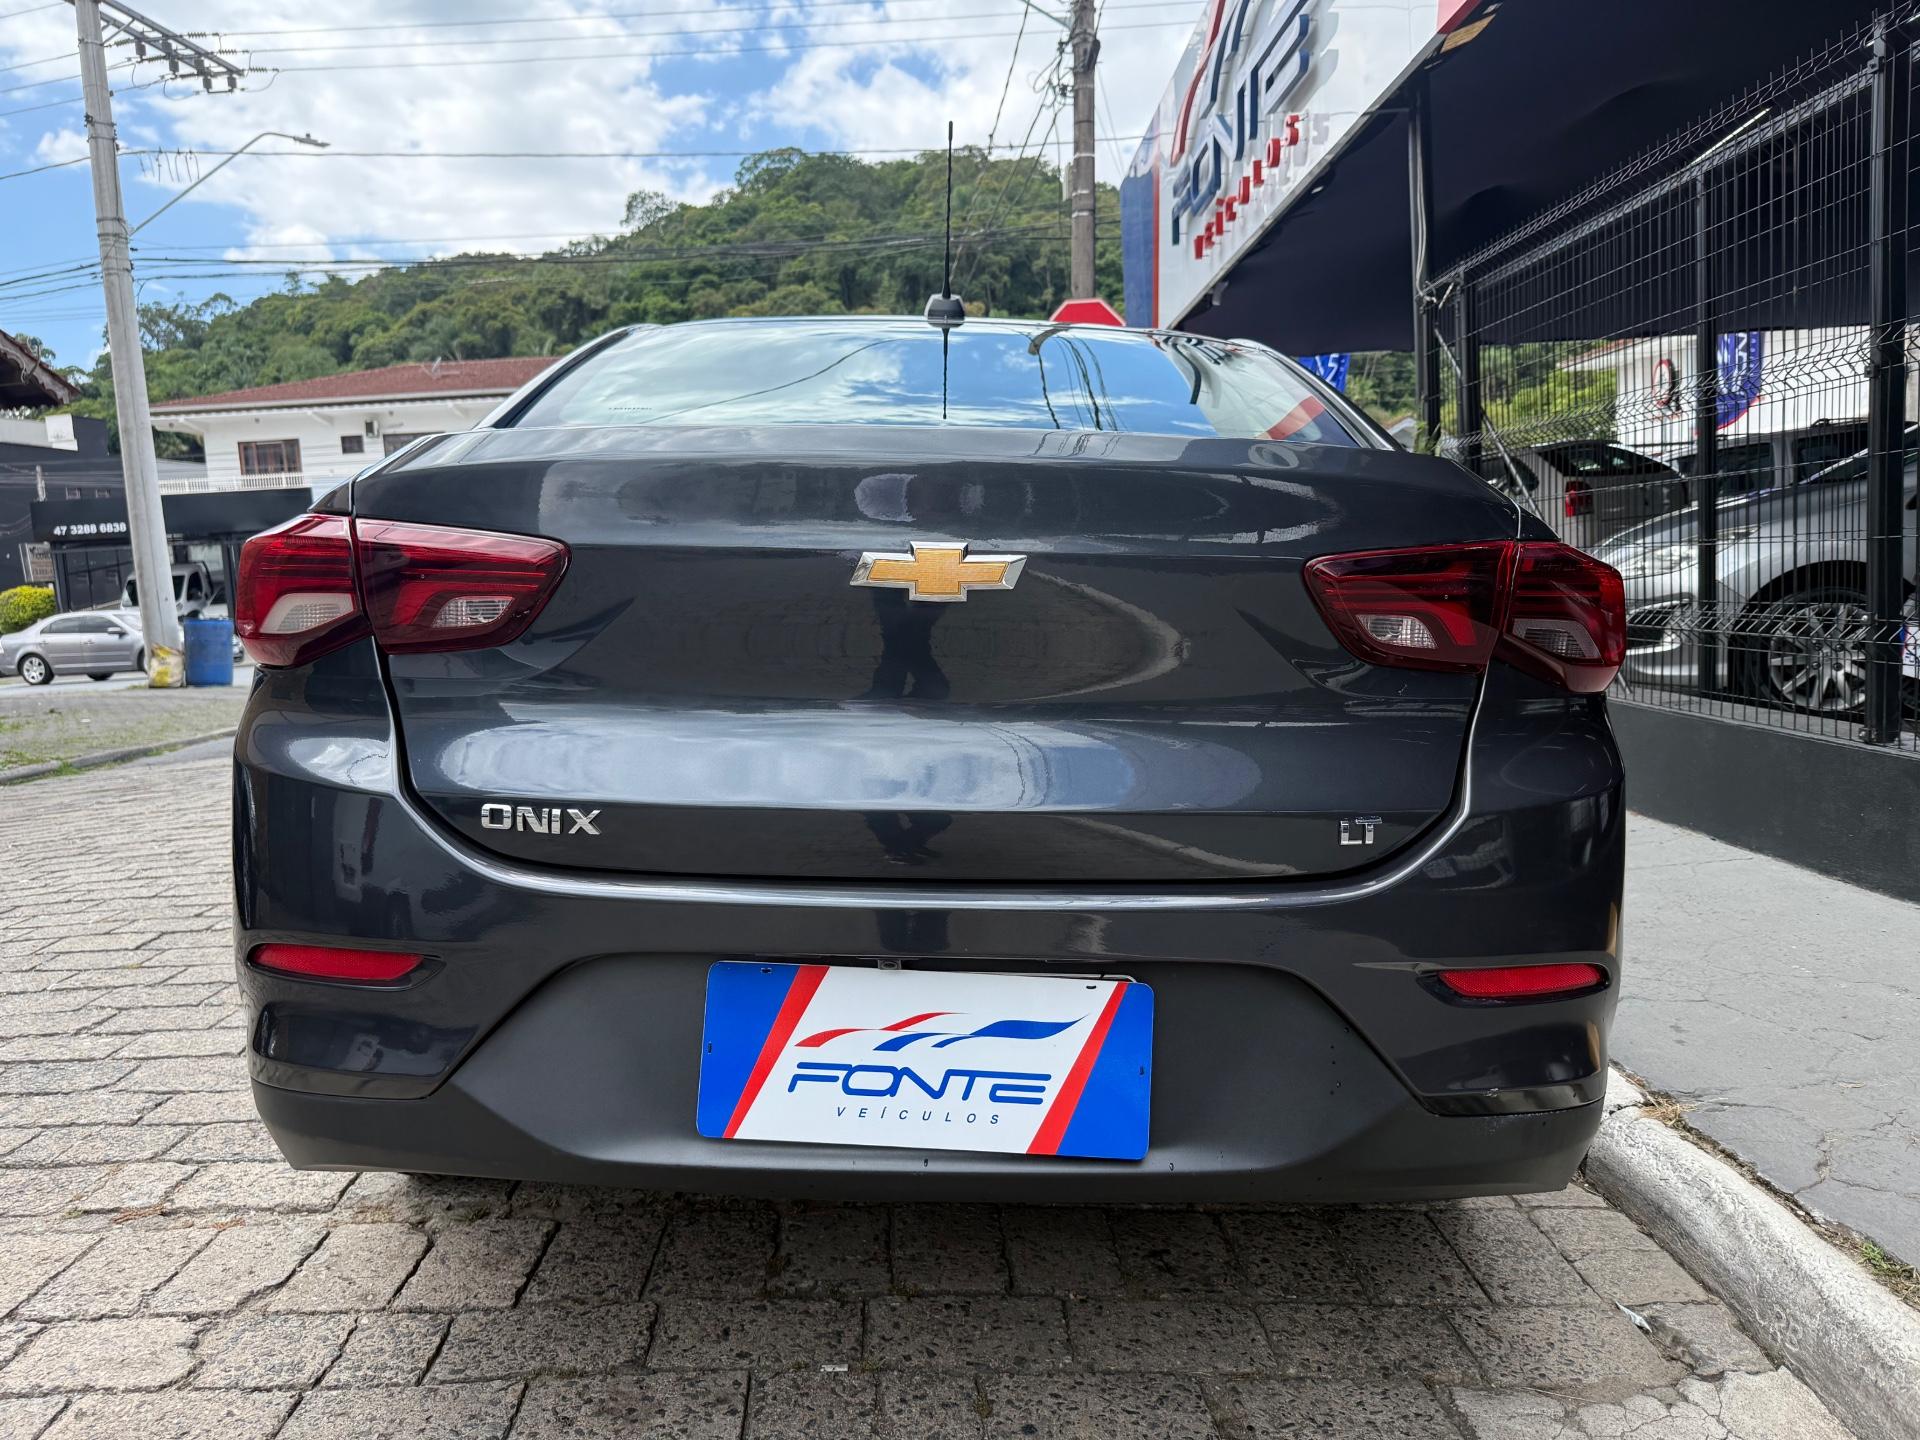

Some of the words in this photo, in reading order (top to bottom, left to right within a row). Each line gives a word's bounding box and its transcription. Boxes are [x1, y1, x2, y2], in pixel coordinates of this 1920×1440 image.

[53, 525, 67, 536] 47
[481, 803, 601, 835] ONIX
[1340, 816, 1383, 846] LT
[787, 1061, 1052, 1105] FONTE
[836, 1106, 1000, 1125] VEÍCULOS
